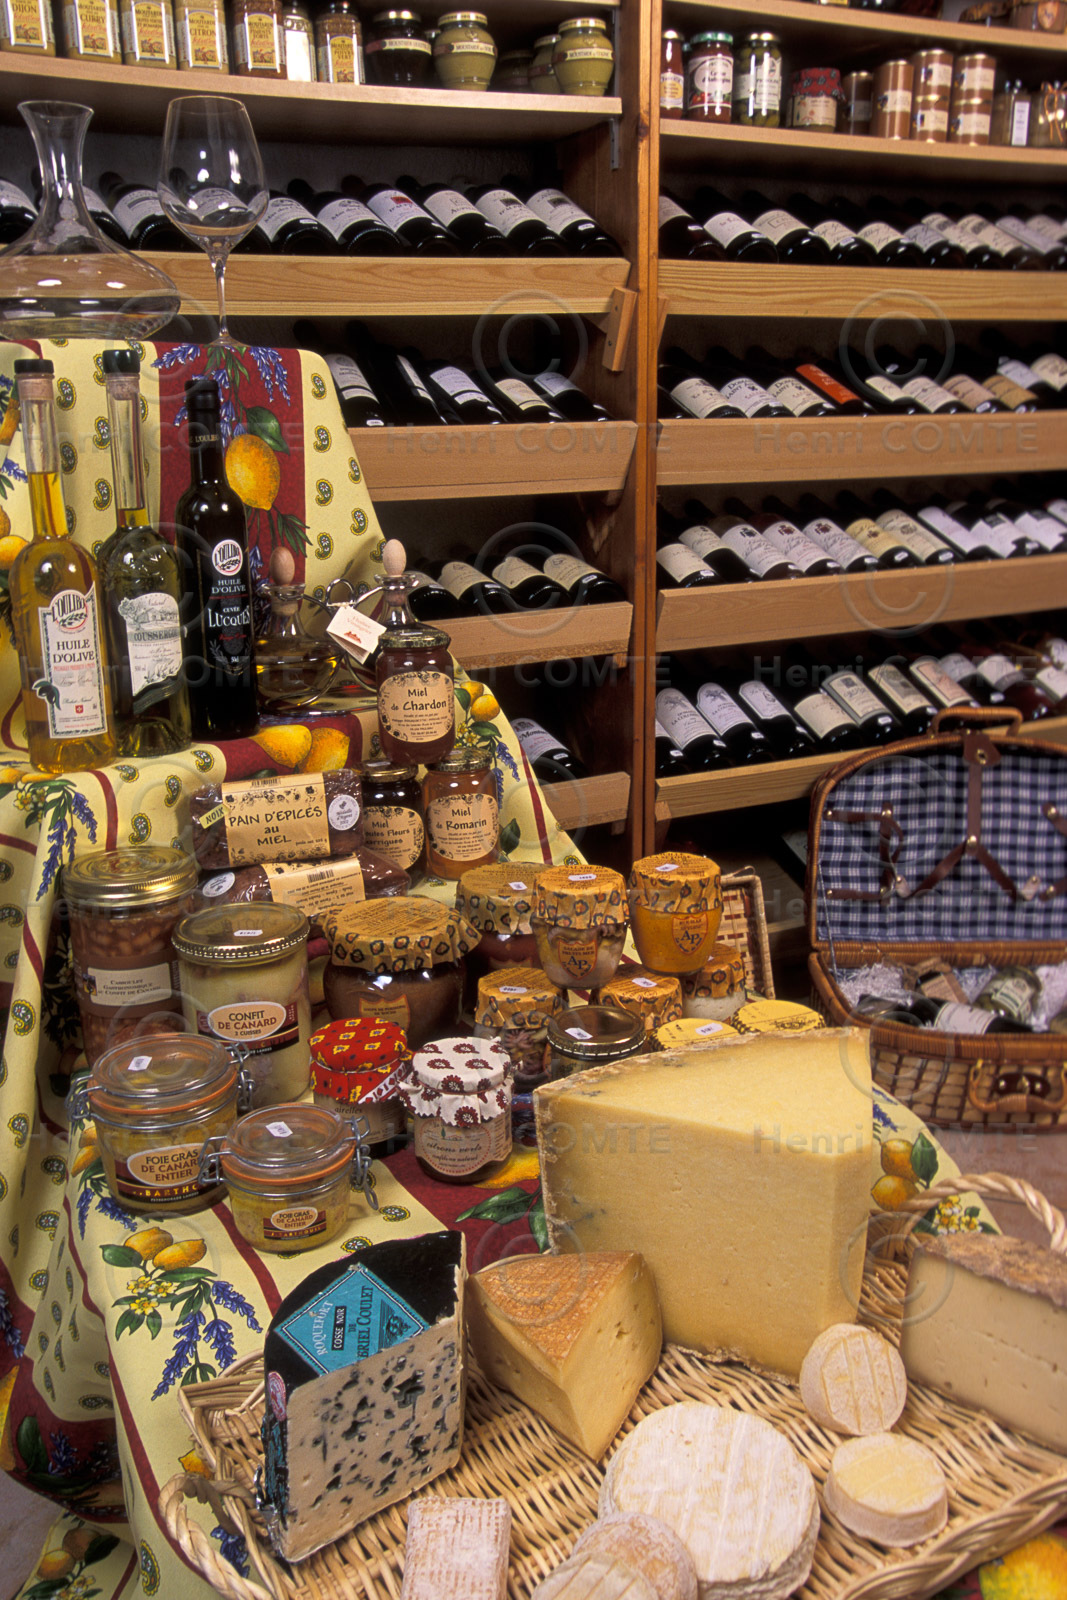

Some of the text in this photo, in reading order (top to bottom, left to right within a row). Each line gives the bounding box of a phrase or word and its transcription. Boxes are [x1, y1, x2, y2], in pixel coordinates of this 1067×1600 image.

[12, 4, 37, 13] DIJON
[190, 28, 216, 37] CITRON
[217, 579, 242, 587] HUILE
[211, 585, 246, 595] D'OLIVE
[56, 639, 90, 651] HUILE
[52, 651, 95, 664] D'OLIVE
[407, 687, 428, 698] Miel
[402, 699, 447, 711] Chardon
[205, 806, 225, 825] NOIX
[228, 806, 323, 827] PAIN D'EPICES
[451, 807, 472, 817] Miel
[264, 825, 280, 834] au
[371, 819, 389, 828] Miel
[446, 819, 487, 831] Romarin
[387, 828, 410, 837] Fleurs
[256, 834, 292, 846] MIEL
[228, 1010, 265, 1022] CONFIT
[217, 1016, 277, 1031] DE CANARD
[146, 1149, 199, 1165] FOIE GRAS
[141, 1165, 156, 1173] DE
[155, 1169, 193, 1181] ENTIER
[286, 1215, 313, 1223] CANARD
[357, 1285, 374, 1327] COULET
[312, 1301, 334, 1356] ROQUEFORT
[333, 1308, 345, 1349] COSSE NOIR
[348, 1323, 357, 1333] DE
